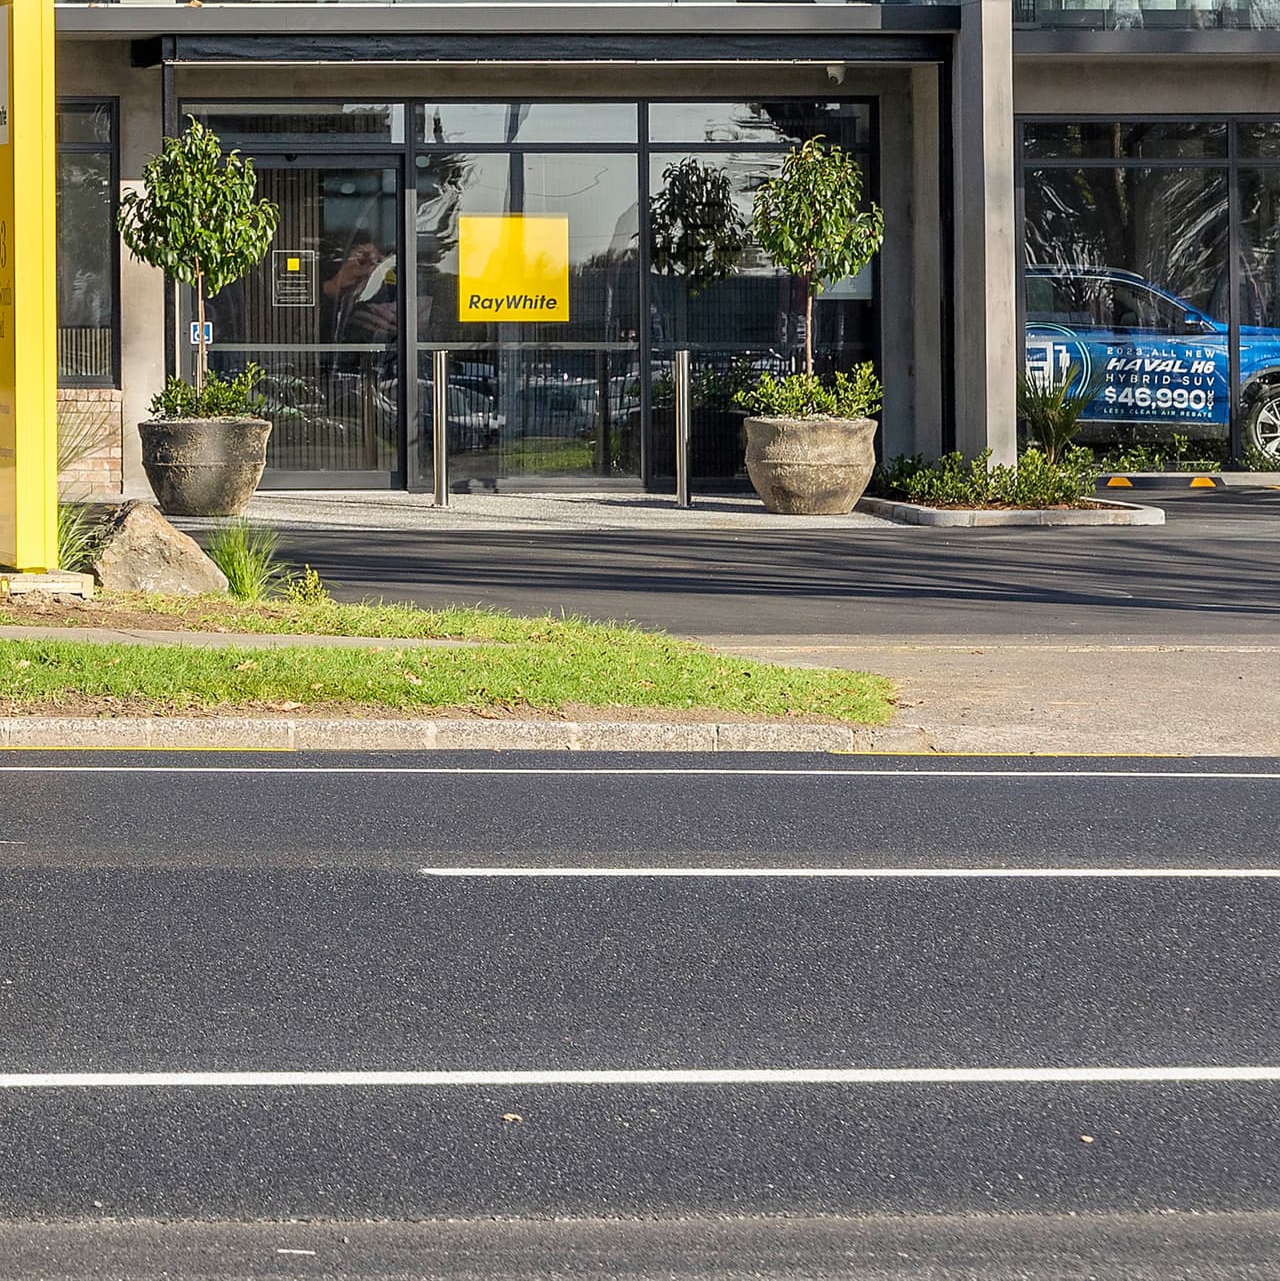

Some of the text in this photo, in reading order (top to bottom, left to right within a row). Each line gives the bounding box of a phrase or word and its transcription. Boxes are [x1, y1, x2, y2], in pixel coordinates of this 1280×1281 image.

[469, 294, 558, 312] RayWhite
[1106, 347, 1215, 359] 2023 ALL NEW
[1106, 357, 1216, 374] HAVAL H6
[1105, 373, 1215, 387] HYBRID SUV
[1104, 386, 1206, 410] $46,990
[1180, 410, 1213, 418] REBATE
